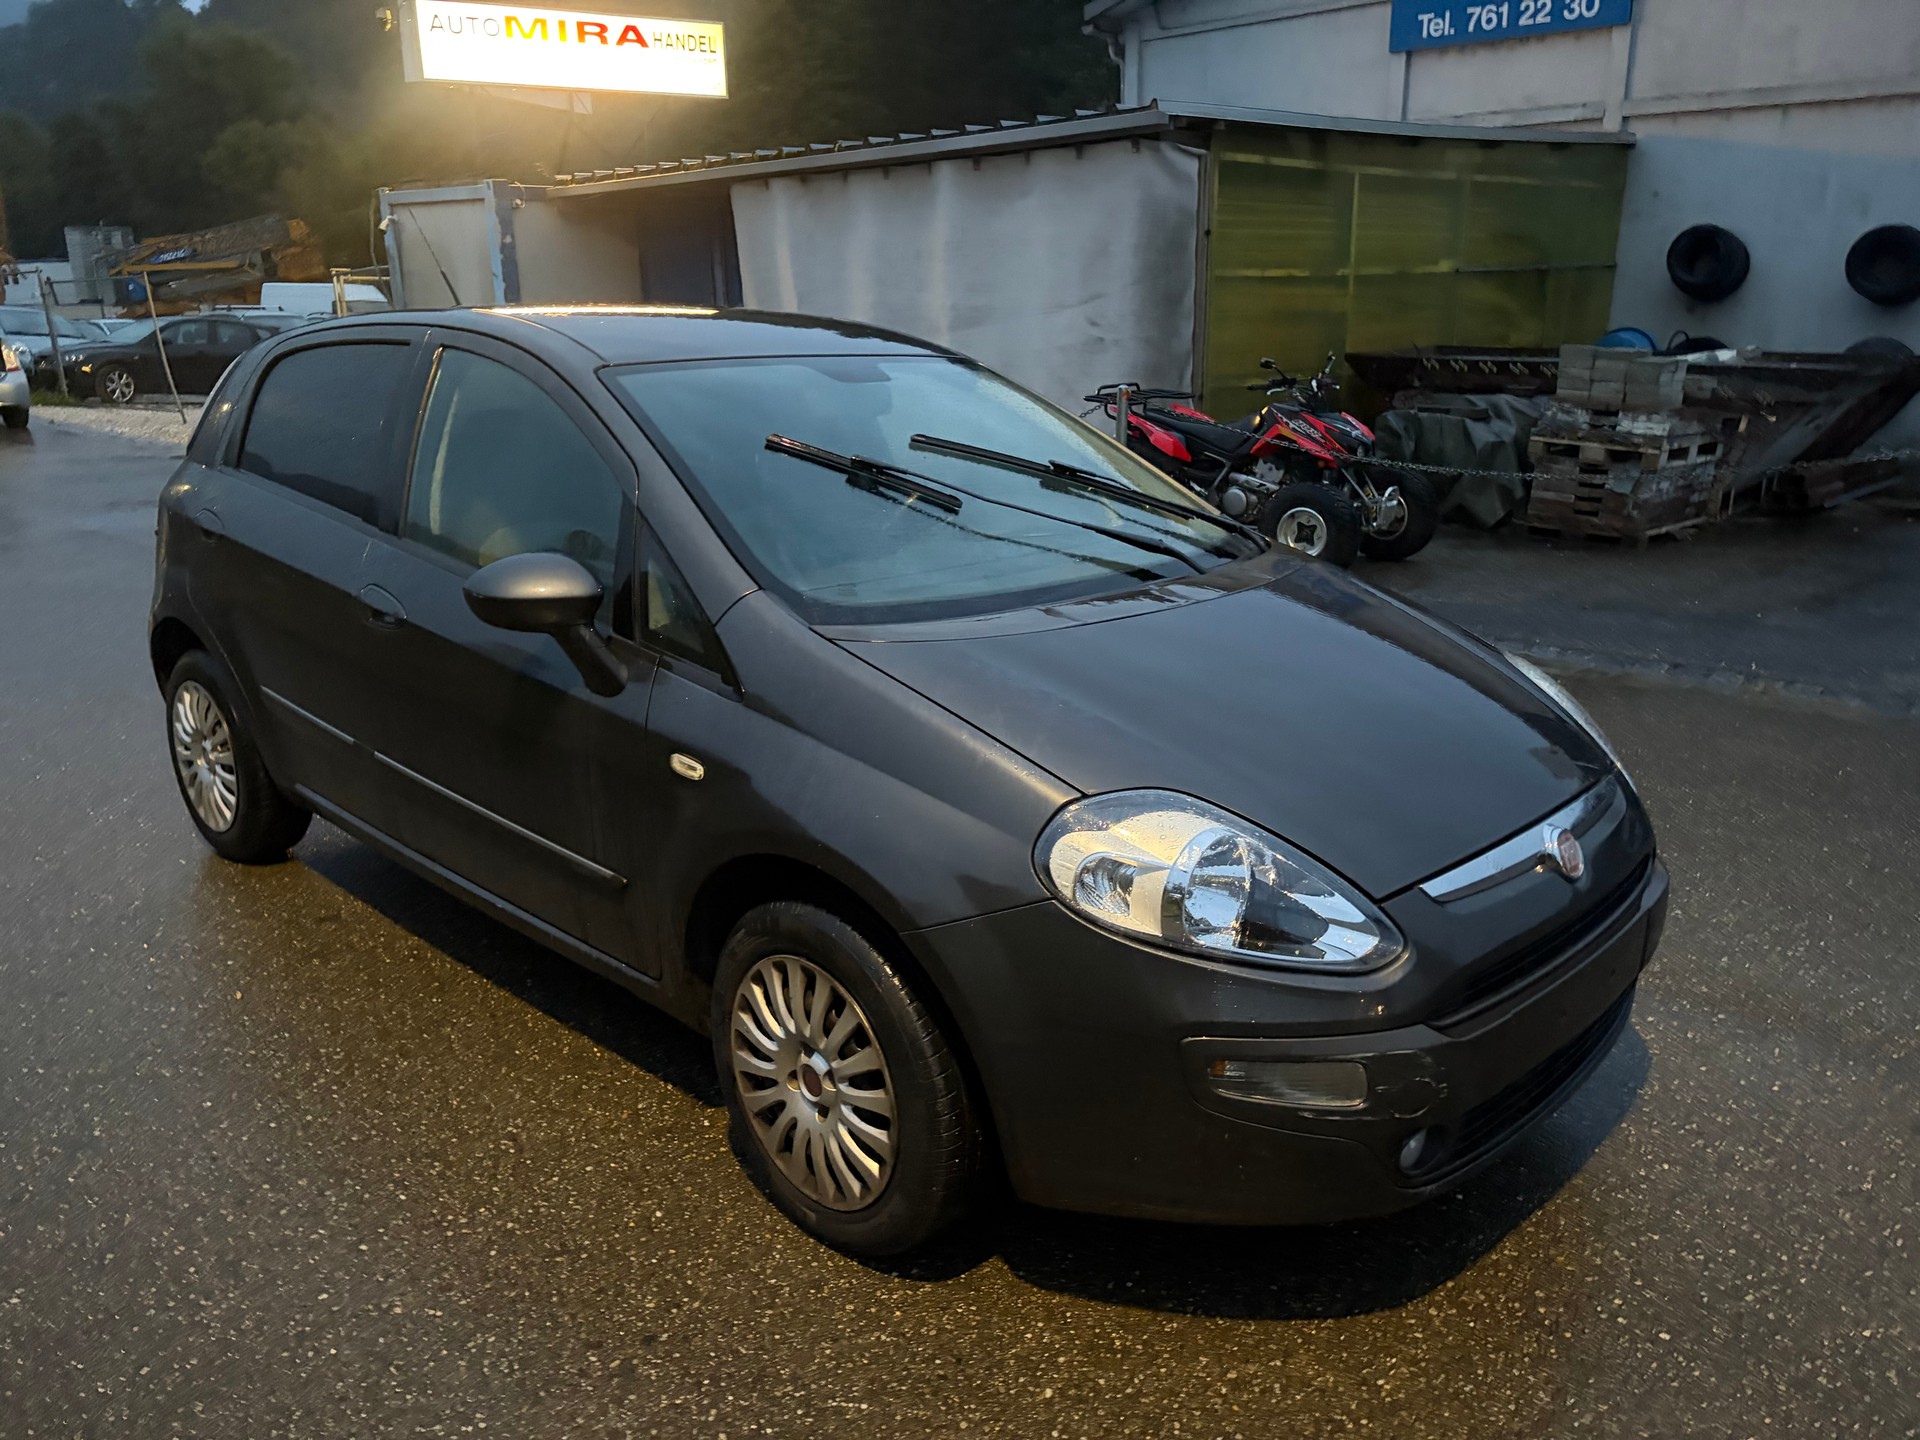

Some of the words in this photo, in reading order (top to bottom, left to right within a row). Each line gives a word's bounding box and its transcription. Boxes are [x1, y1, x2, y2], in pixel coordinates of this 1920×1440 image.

[430, 14, 500, 37] AUTO
[504, 15, 649, 48] MIRA
[652, 31, 717, 54] HANDEL
[1418, 10, 1455, 38] Tel.
[1466, 1, 1508, 33] 761
[1518, 0, 1552, 26] 22
[1563, 0, 1600, 20] 30
